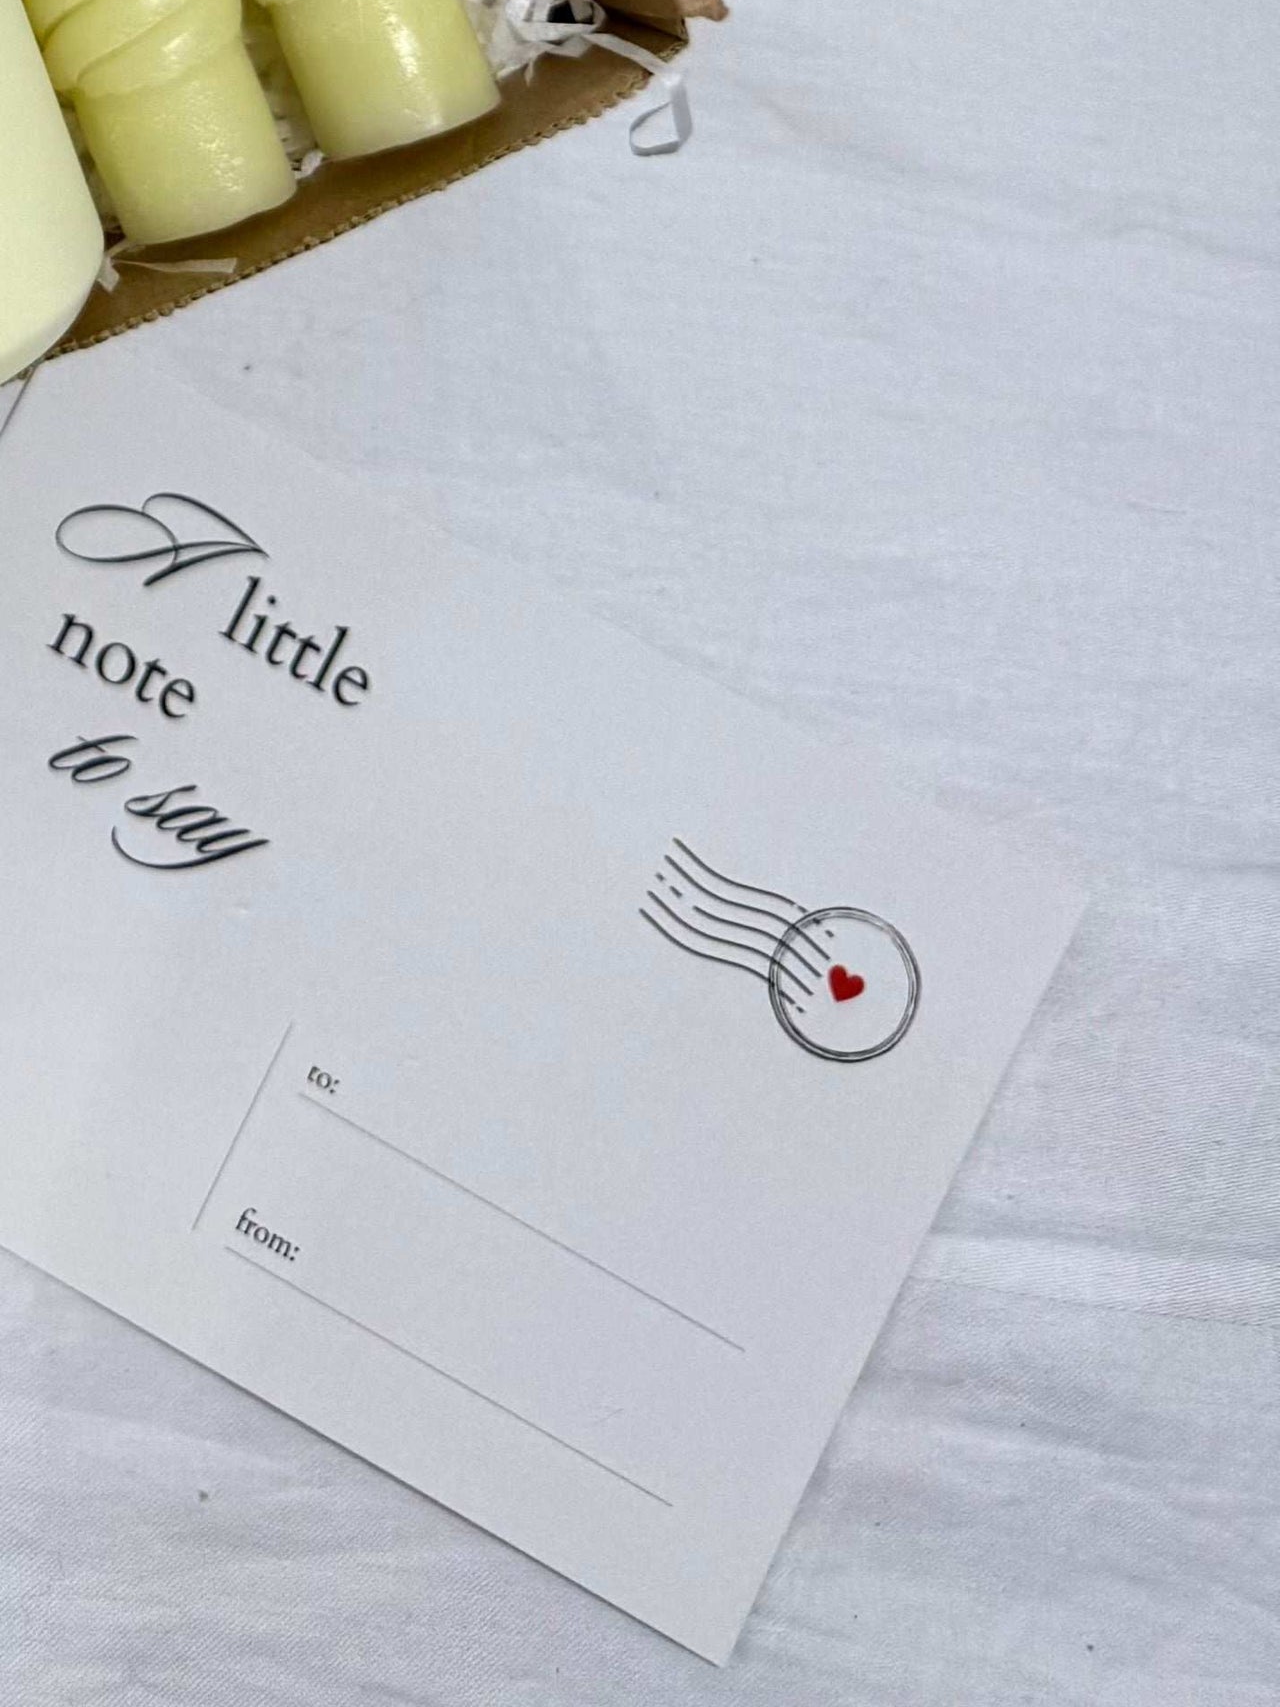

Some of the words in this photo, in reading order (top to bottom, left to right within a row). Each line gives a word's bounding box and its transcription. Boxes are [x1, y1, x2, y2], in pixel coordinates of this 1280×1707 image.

[54, 491, 269, 587] A
[218, 575, 372, 707] little
[47, 612, 197, 719] note
[48, 734, 139, 783] to
[111, 784, 270, 870] say
[306, 1065, 340, 1095] to:
[235, 1206, 301, 1262] from:
